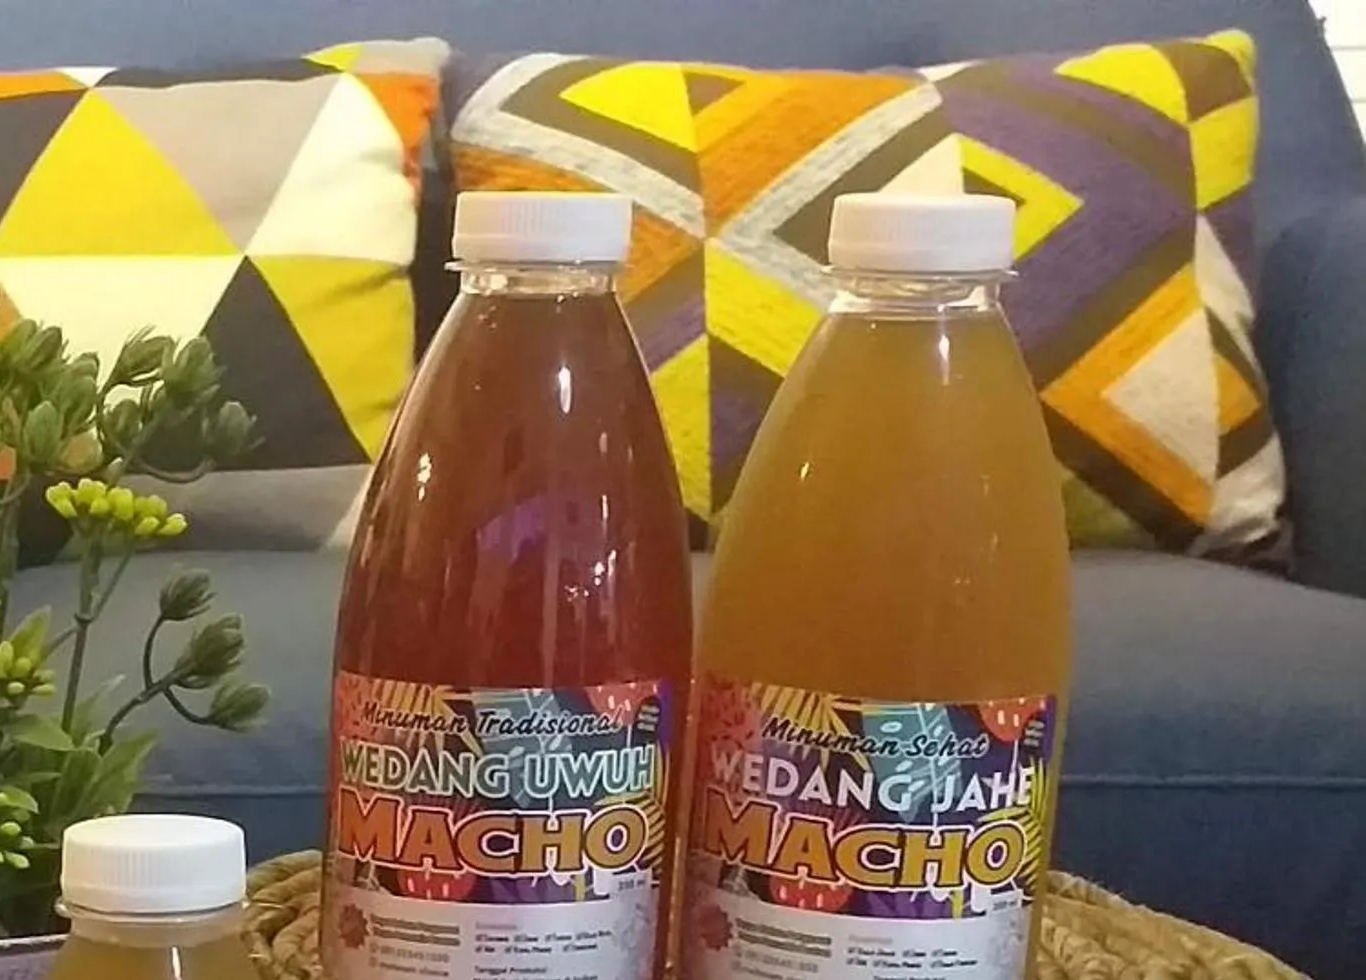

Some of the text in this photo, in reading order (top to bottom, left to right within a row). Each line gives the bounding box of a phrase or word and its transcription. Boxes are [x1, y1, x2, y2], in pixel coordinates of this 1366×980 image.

[364, 701, 468, 734] Minuman
[476, 703, 625, 735] Tradisional
[761, 717, 901, 756] Minuman
[905, 732, 989, 759] Sehat
[340, 737, 655, 798] WEDANG UWUH
[711, 745, 1036, 813] WEDANG JAHE
[338, 785, 649, 876] MACHO
[703, 785, 1028, 891] MACHO
